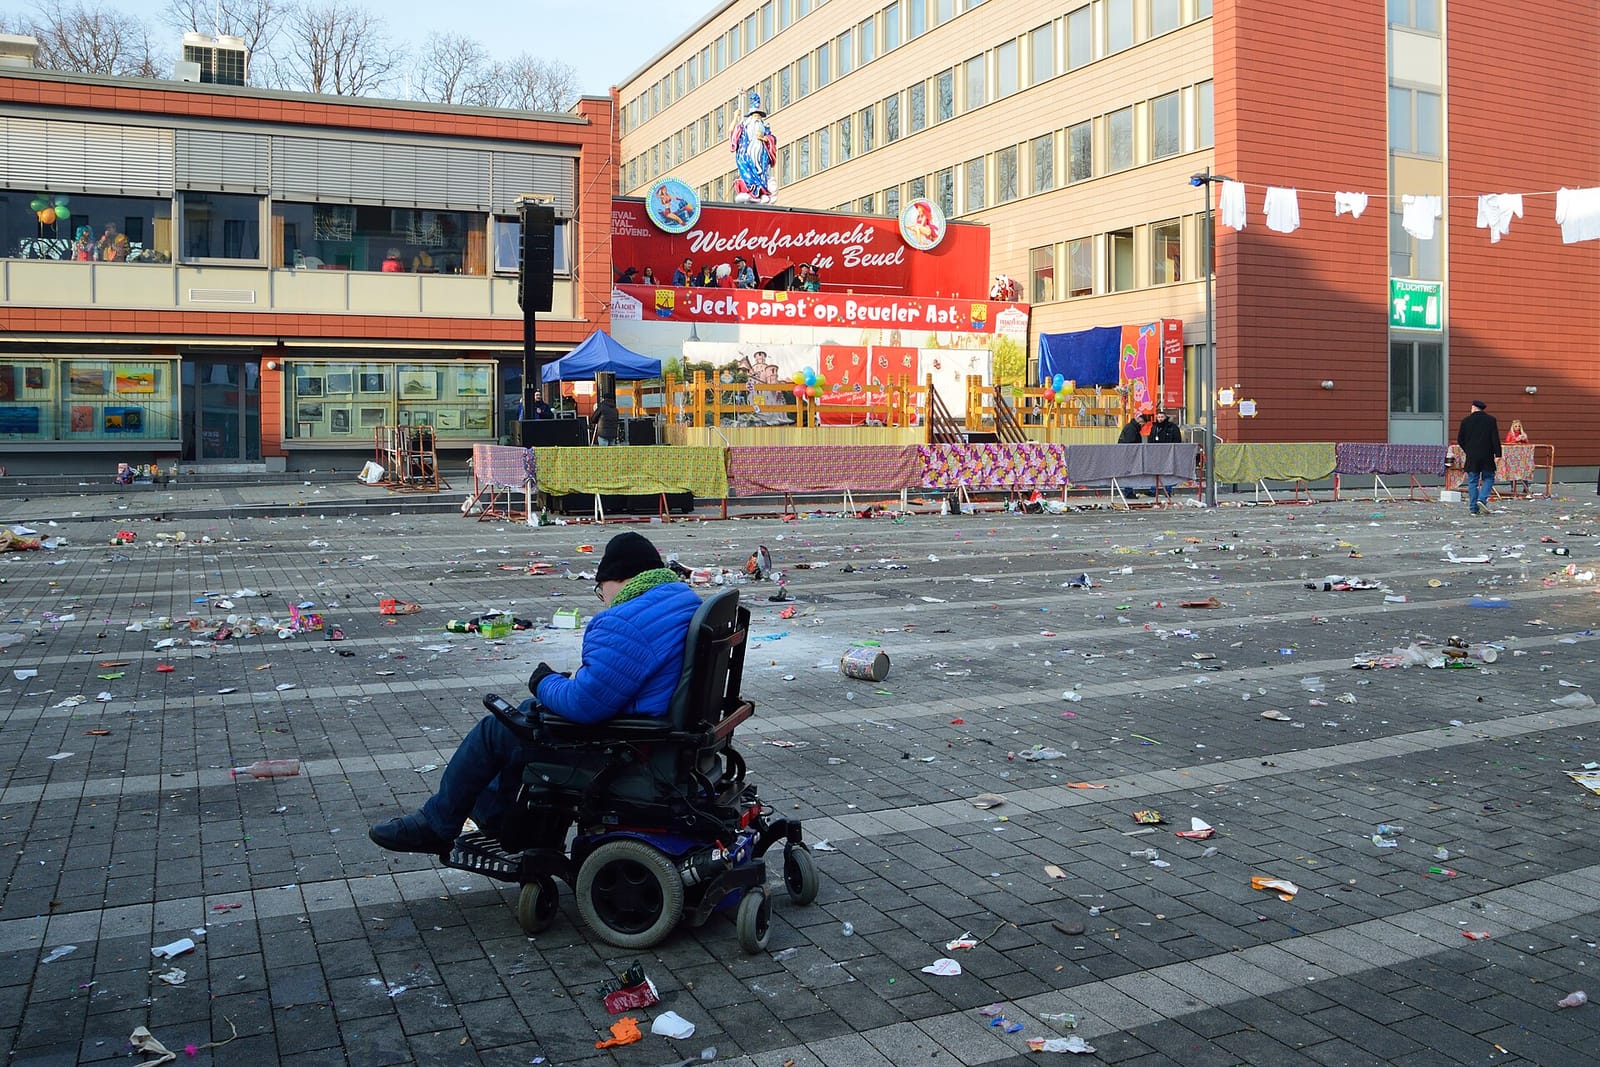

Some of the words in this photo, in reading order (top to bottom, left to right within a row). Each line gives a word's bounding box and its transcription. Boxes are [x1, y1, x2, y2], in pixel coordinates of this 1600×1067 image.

[687, 222, 875, 256] Weiberfastnacht
[811, 252, 834, 269] in
[842, 244, 905, 268] Beuel
[690, 294, 739, 316] Jeck
[747, 299, 807, 319] parat
[814, 303, 838, 323] op
[845, 299, 920, 323] Beueler
[926, 304, 958, 324] Aat
